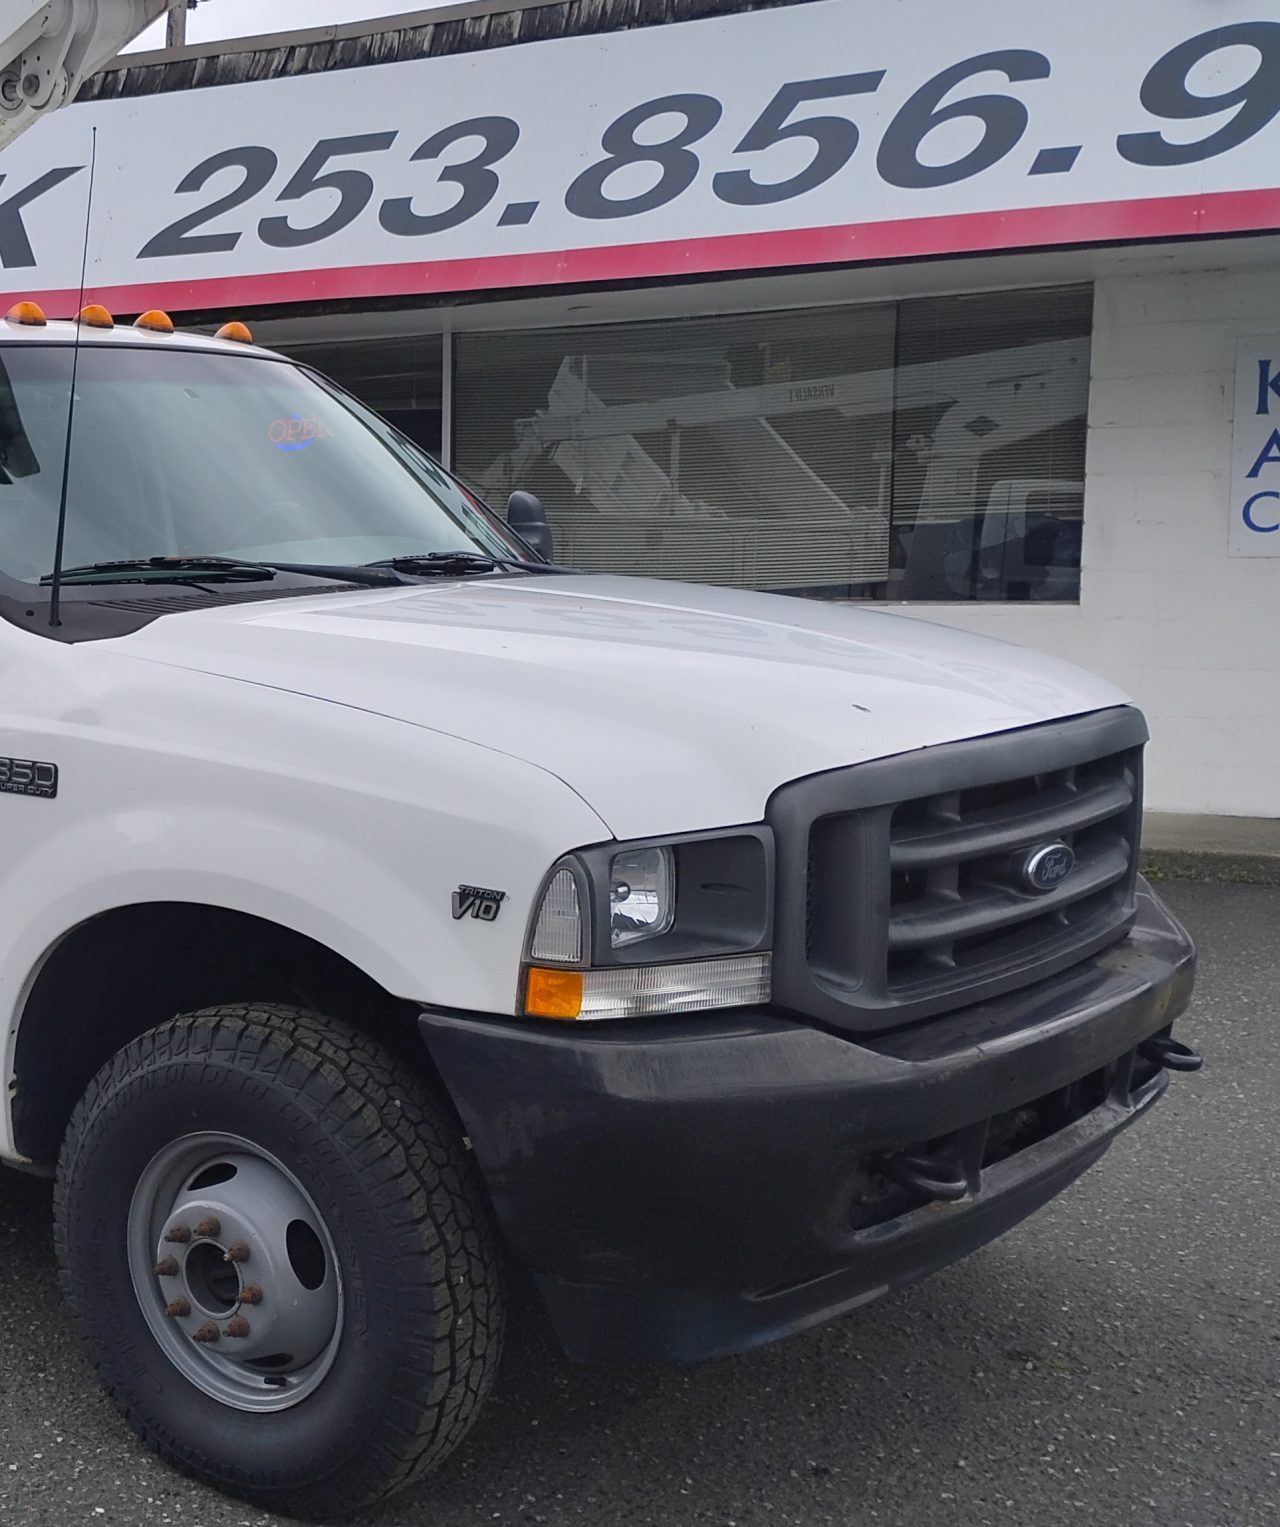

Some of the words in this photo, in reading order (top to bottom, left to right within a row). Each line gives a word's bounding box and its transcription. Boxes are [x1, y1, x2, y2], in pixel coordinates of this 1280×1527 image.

[27, 785, 54, 797] DUTY
[1041, 853, 1067, 881] Ford
[459, 885, 503, 900] TRITON
[451, 891, 498, 921] V10
